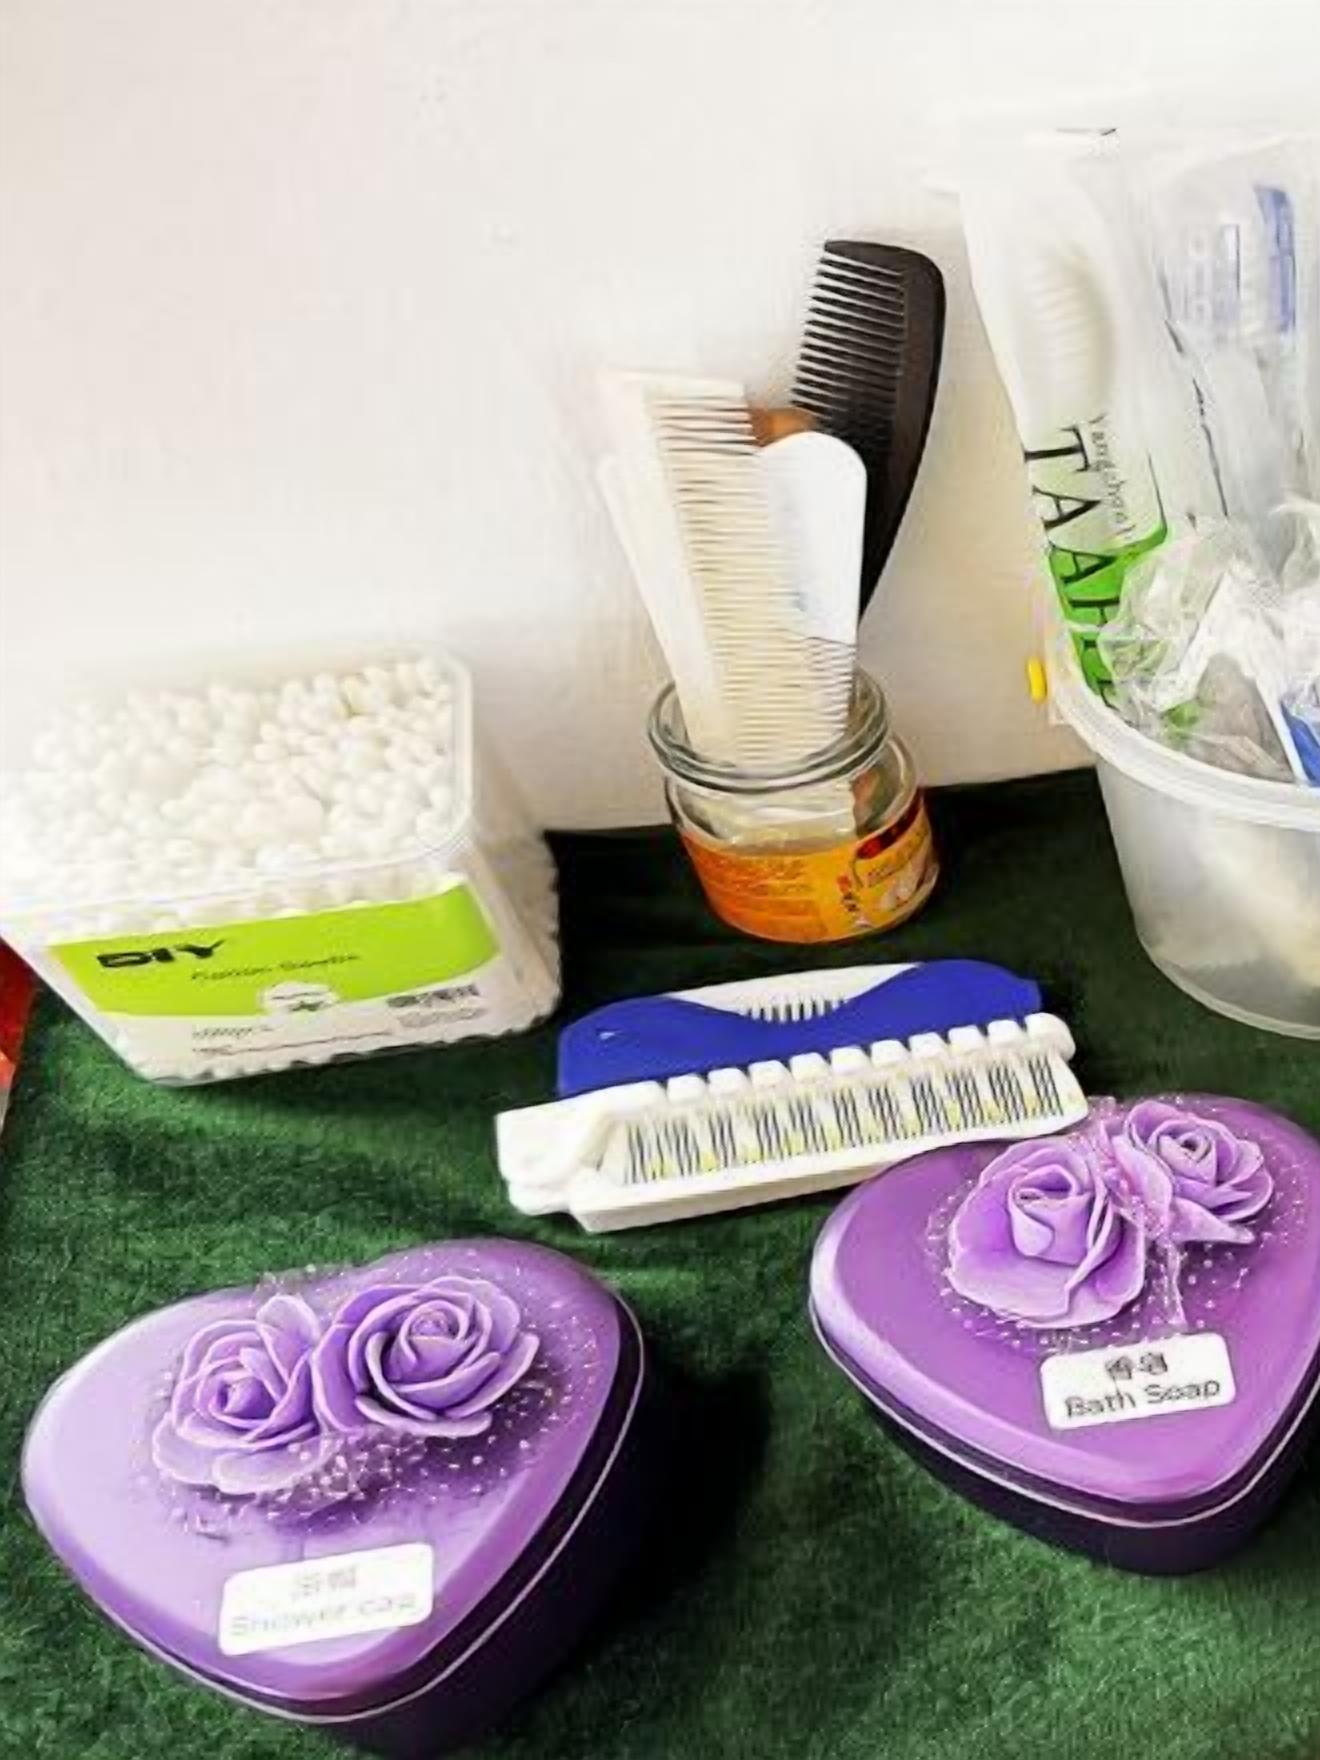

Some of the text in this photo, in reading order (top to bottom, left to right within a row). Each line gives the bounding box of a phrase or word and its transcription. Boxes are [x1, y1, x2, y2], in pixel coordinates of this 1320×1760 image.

[1065, 1380, 1220, 1418] Bath Soap
[230, 1601, 347, 1637] Shower
